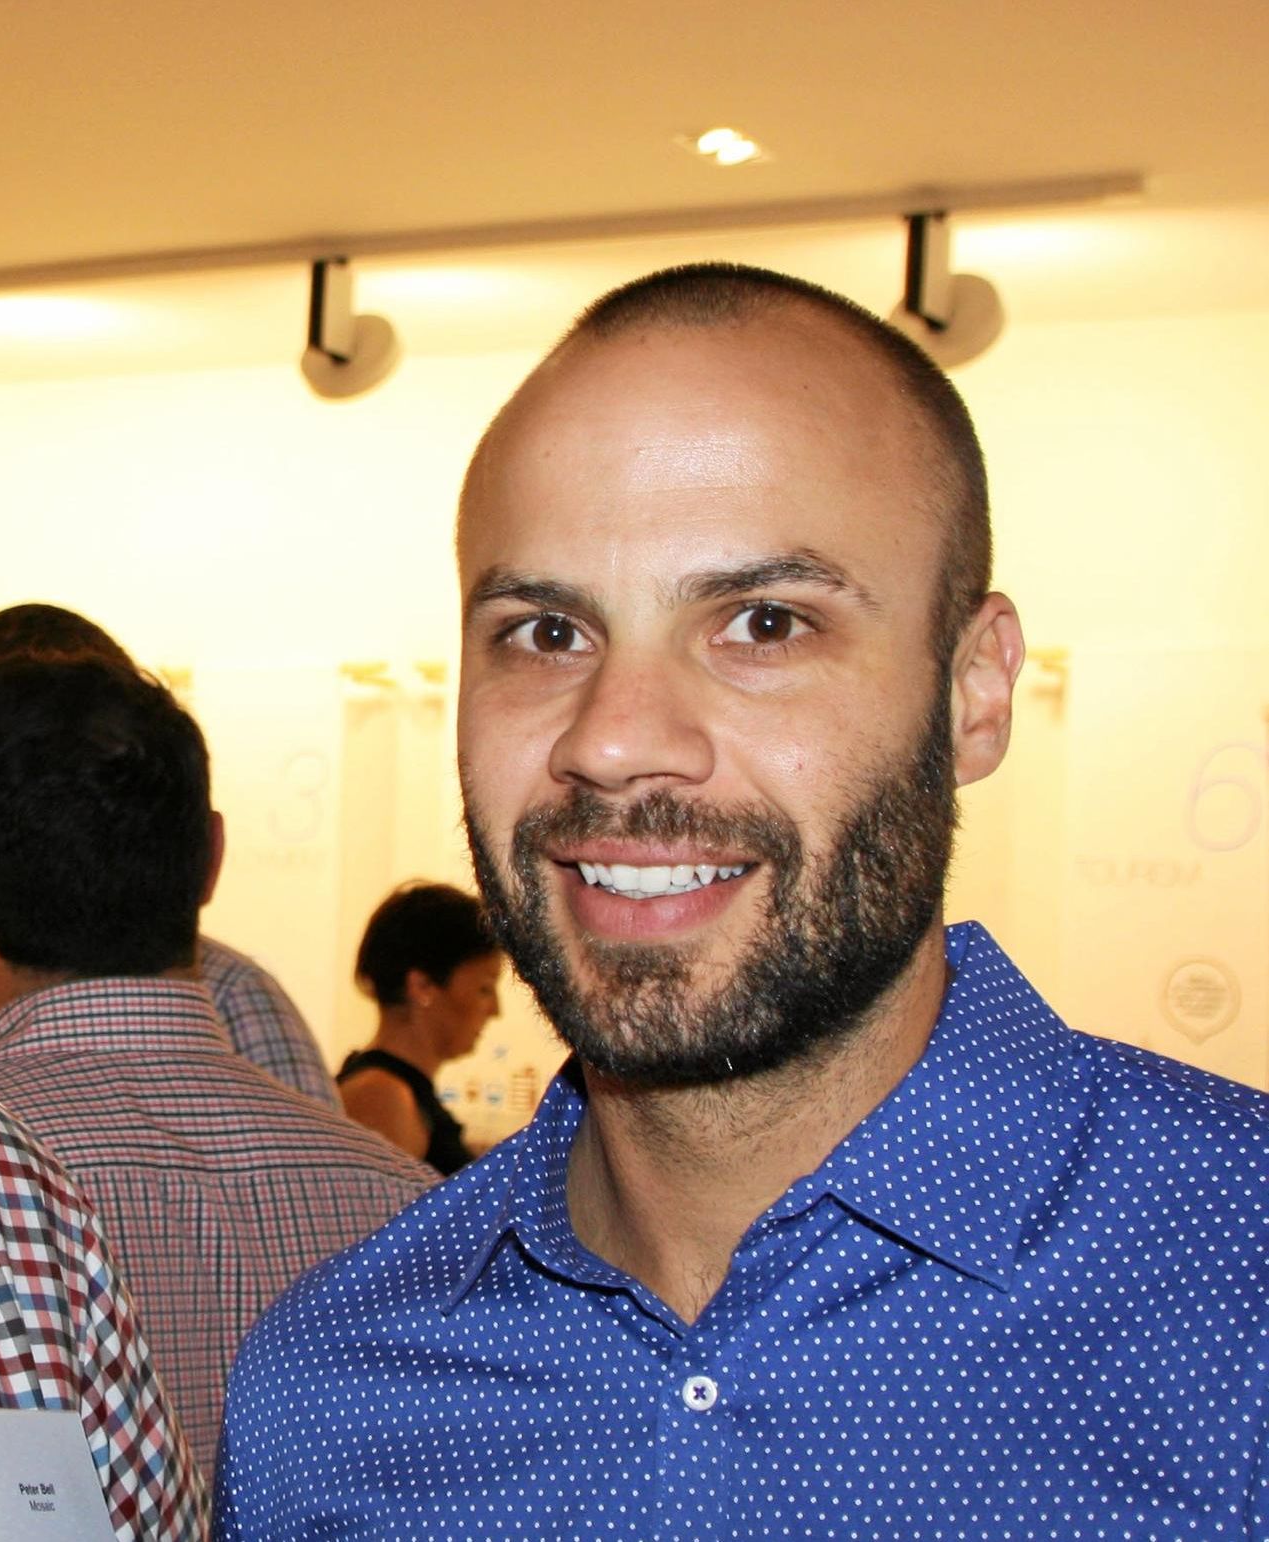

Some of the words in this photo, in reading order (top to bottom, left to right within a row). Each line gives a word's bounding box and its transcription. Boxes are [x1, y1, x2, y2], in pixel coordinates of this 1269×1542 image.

[18, 1482, 39, 1495] Peter
[40, 1482, 56, 1495] Bell
[28, 1500, 56, 1512] Mosaic
